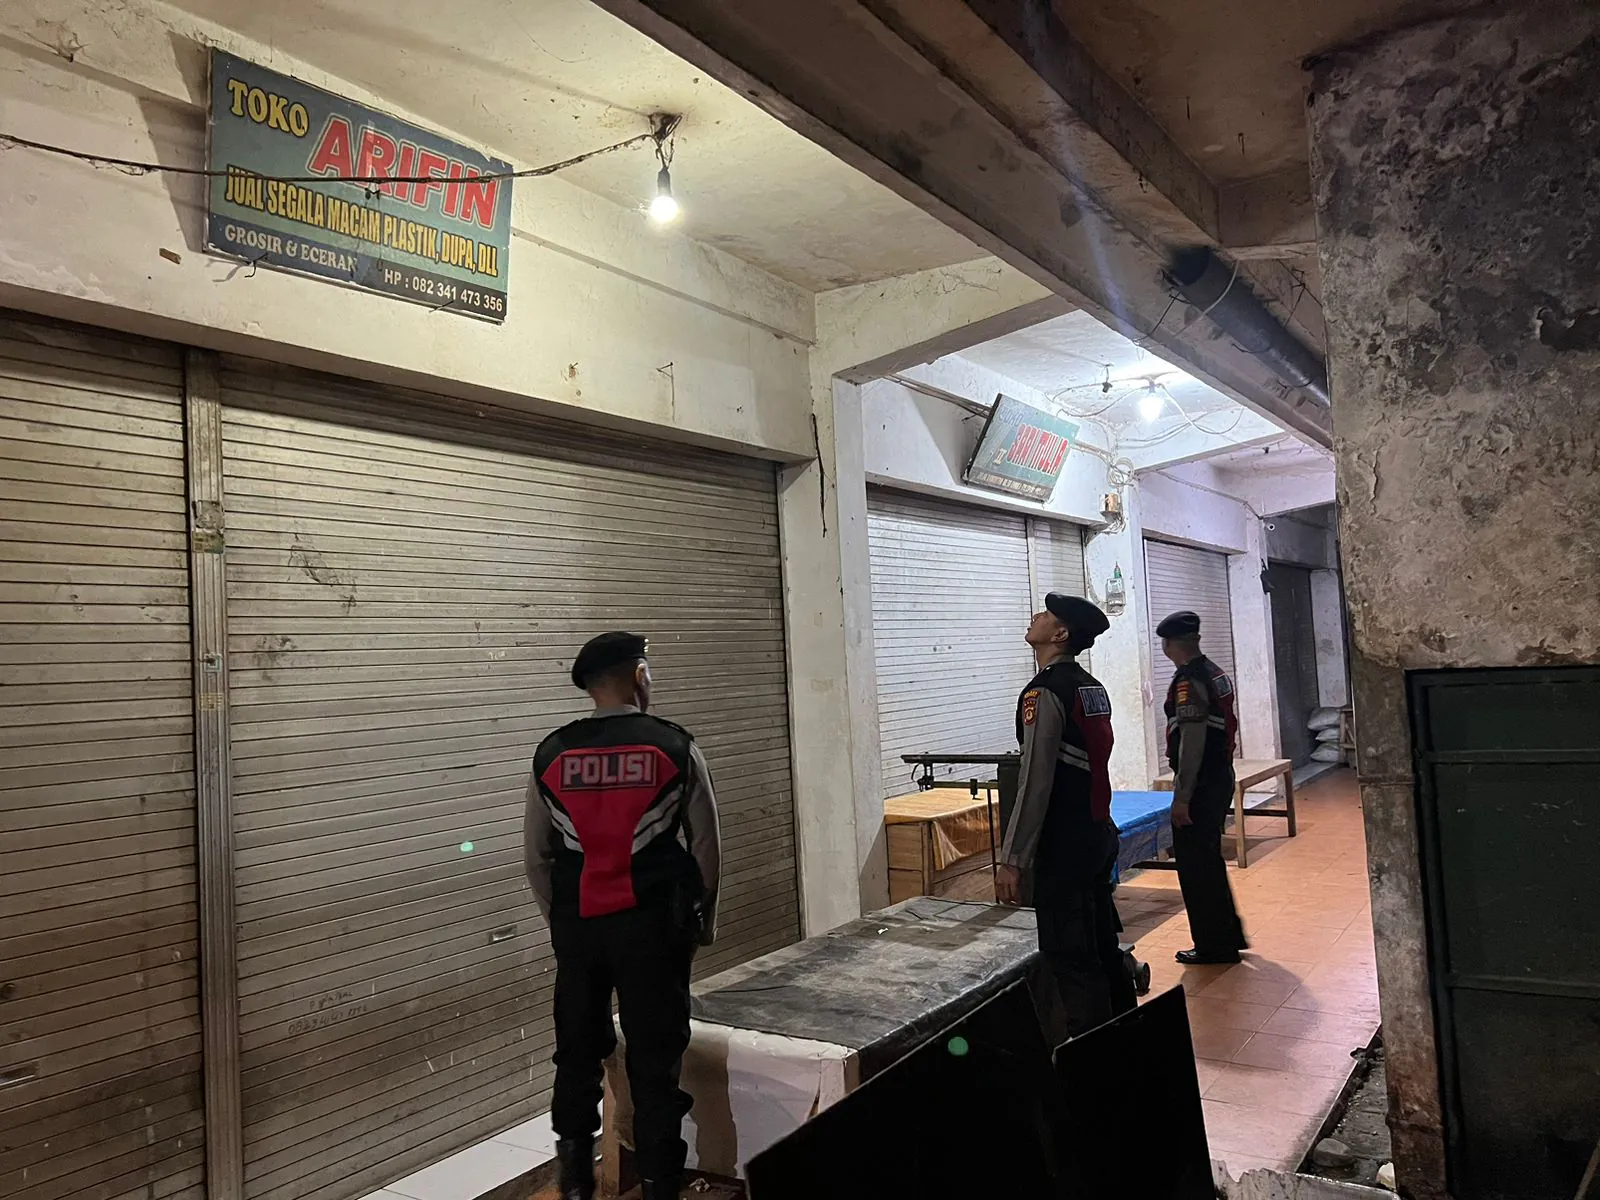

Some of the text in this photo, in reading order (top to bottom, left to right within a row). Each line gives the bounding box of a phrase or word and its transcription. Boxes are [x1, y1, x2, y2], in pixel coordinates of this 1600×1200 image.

[228, 79, 309, 137] TOKO
[307, 113, 500, 230] ARIFIN
[225, 164, 498, 277] JUAL SEGALA MACAM PLASTIK, DUPA, DLL
[225, 224, 358, 273] GROSIR & ECERAN
[384, 268, 402, 286] HP
[412, 276, 434, 294] 082
[437, 282, 457, 300] 341
[461, 289, 481, 307] 473
[484, 295, 503, 312] 356
[563, 753, 651, 786] POLISI
